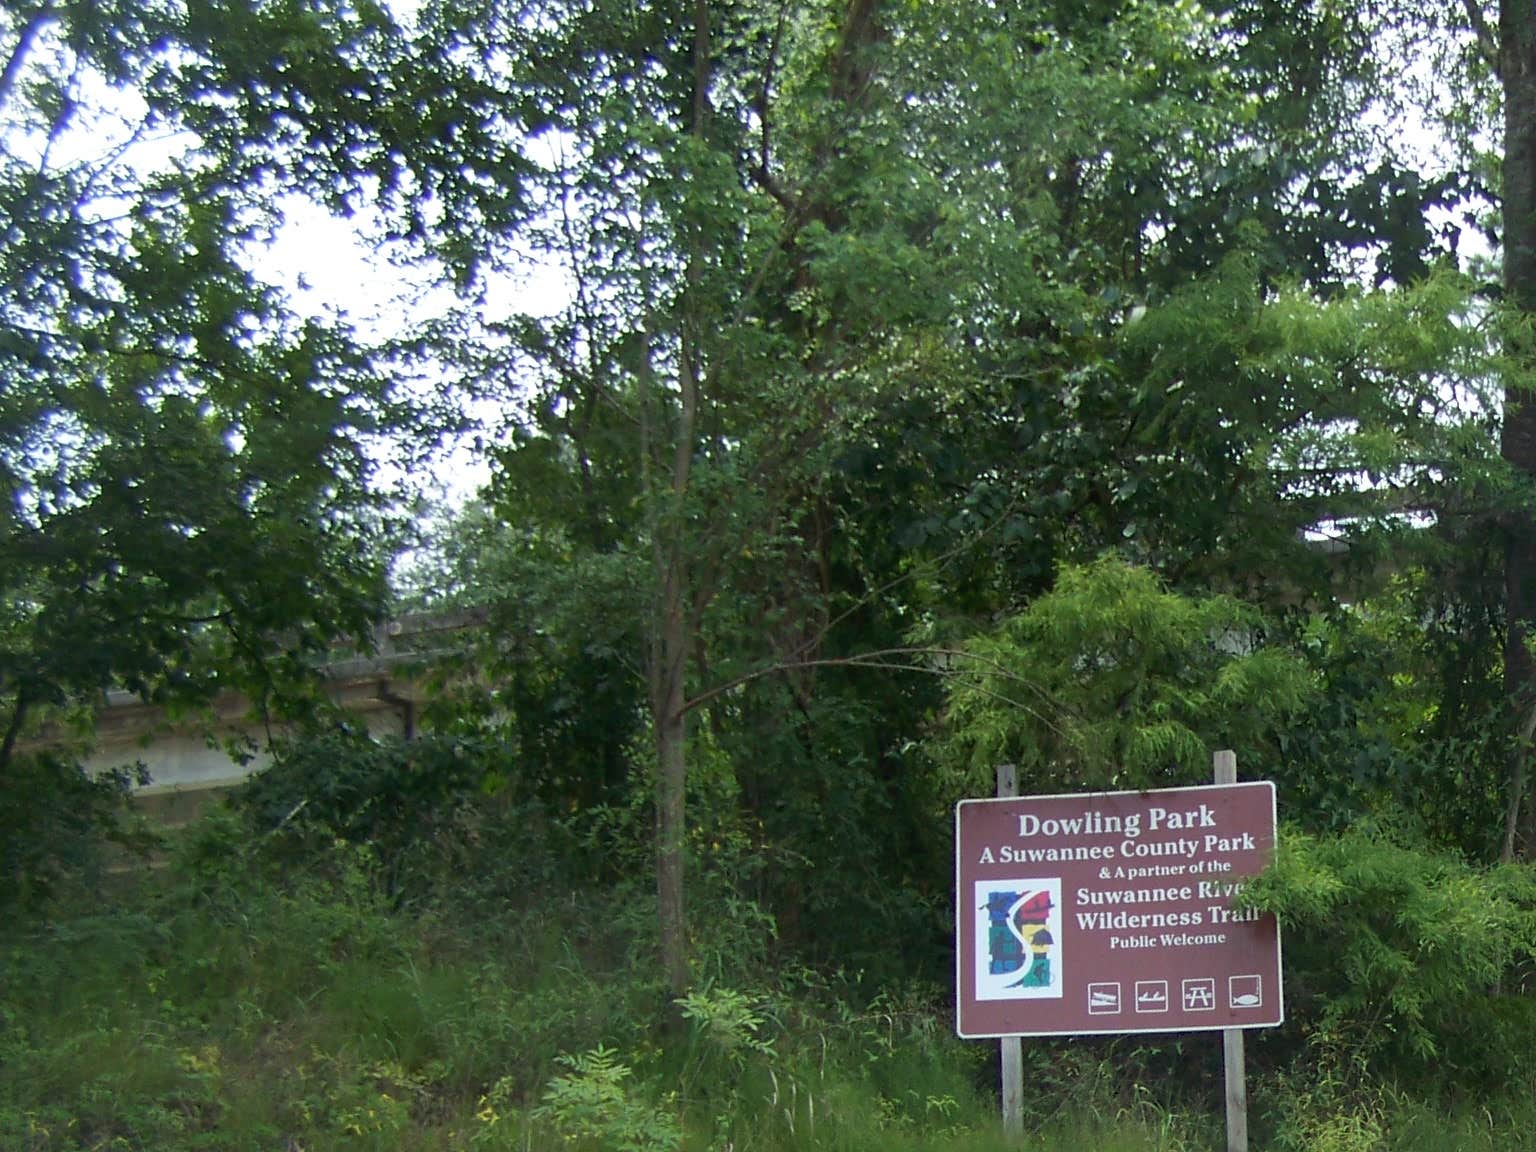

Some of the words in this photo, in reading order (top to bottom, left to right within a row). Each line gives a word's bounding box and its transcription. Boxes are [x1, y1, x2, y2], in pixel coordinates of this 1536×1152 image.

[1019, 811, 1141, 838] Dowling
[1149, 804, 1216, 830] Park
[979, 847, 995, 864] A
[1000, 842, 1115, 863] Suwannee
[1120, 837, 1199, 858] County
[1204, 832, 1255, 852] Park
[1099, 866, 1111, 879] &
[1114, 866, 1125, 878] A
[1128, 862, 1186, 880] partner
[1189, 861, 1204, 874] of
[1207, 860, 1232, 873] the
[1076, 885, 1192, 906] Suwannee
[1198, 880, 1250, 899] Rive
[1076, 911, 1202, 931] Wilderness
[1208, 905, 1260, 924] Trail
[1110, 934, 1156, 949] Public
[1160, 933, 1226, 947] Welcome
